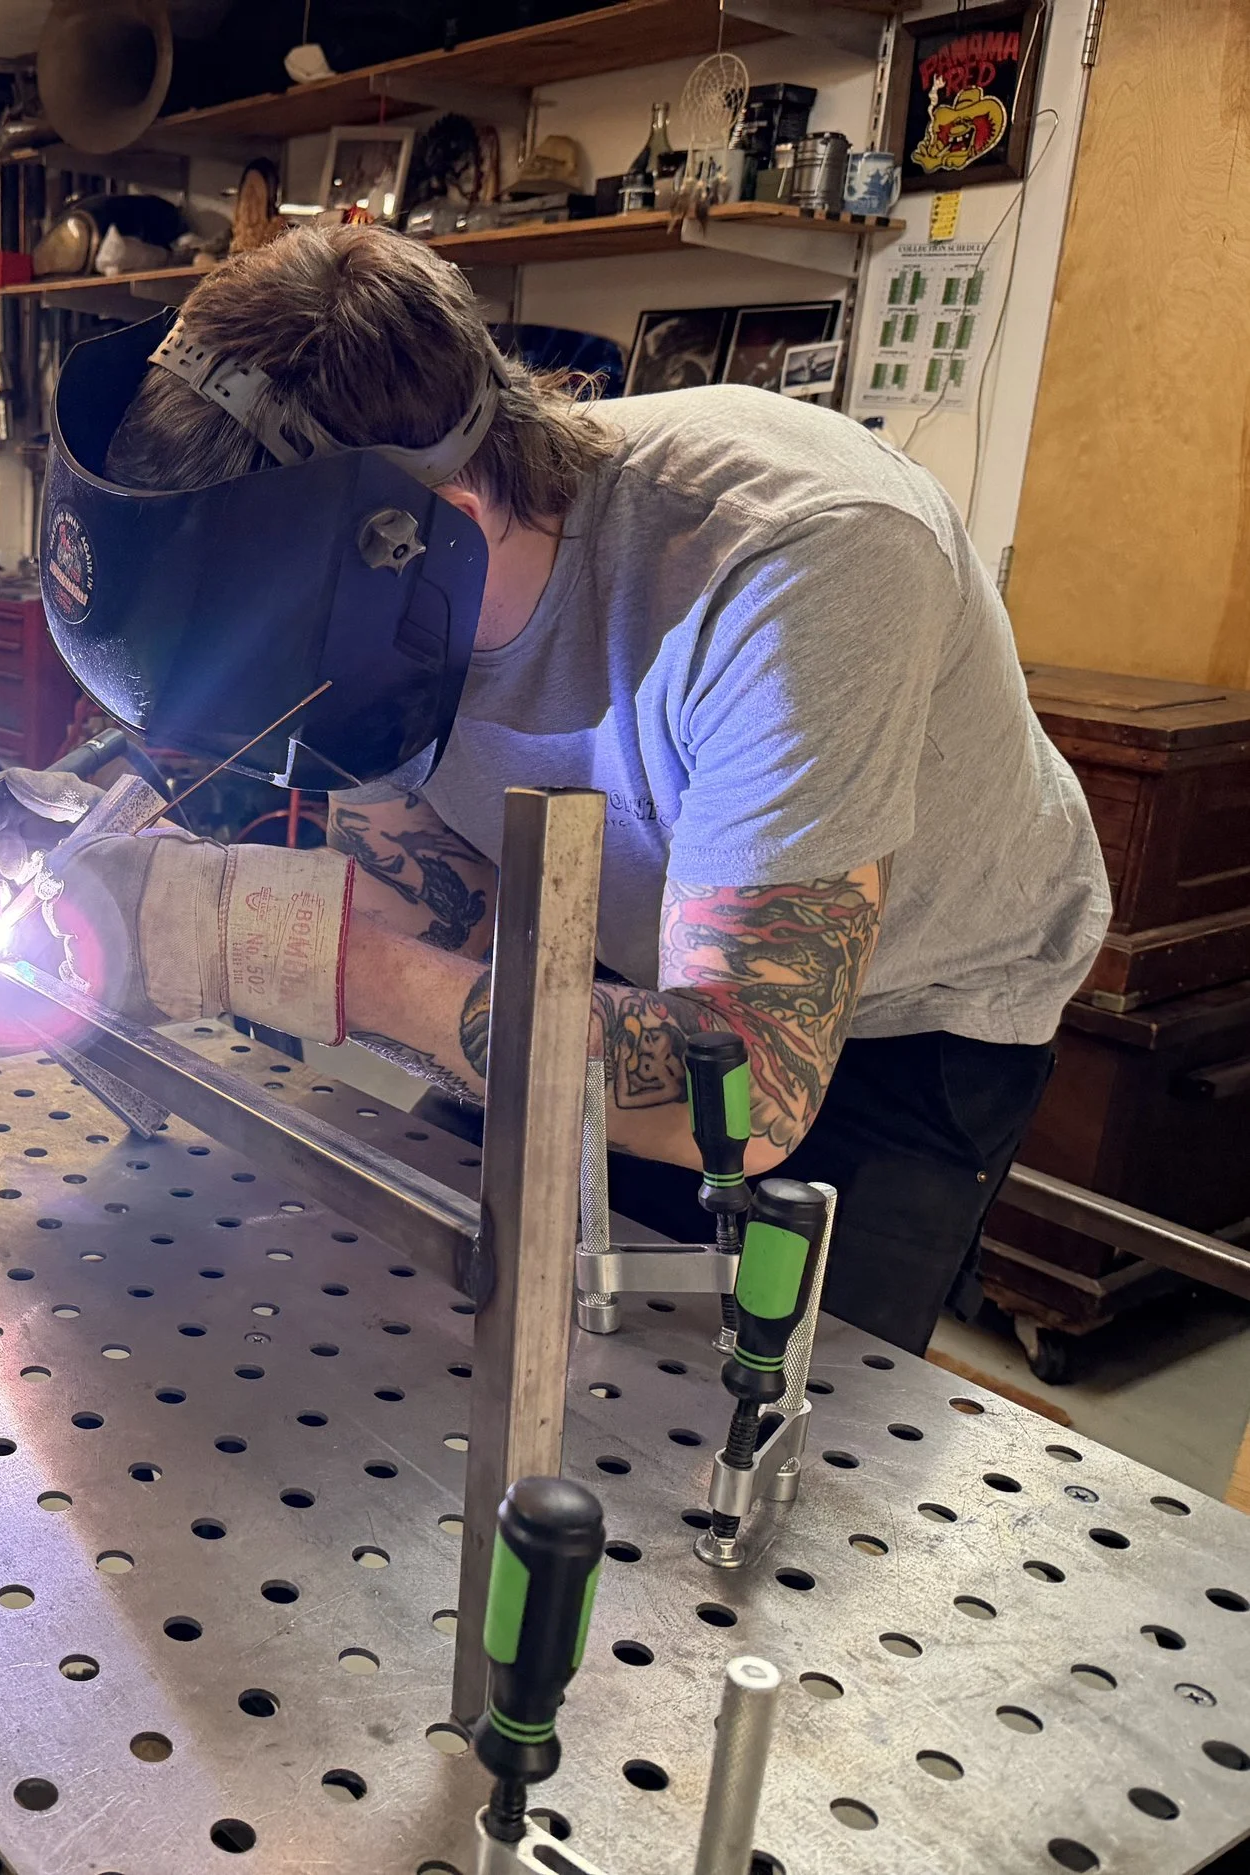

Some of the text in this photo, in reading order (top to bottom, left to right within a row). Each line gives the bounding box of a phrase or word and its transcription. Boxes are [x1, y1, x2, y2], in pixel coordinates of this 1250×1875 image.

[918, 31, 1020, 92] PANAMA
[945, 61, 997, 97] RED
[80, 536, 93, 574] AGAIN
[86, 576, 94, 591] IN
[246, 932, 266, 996] No. 502
